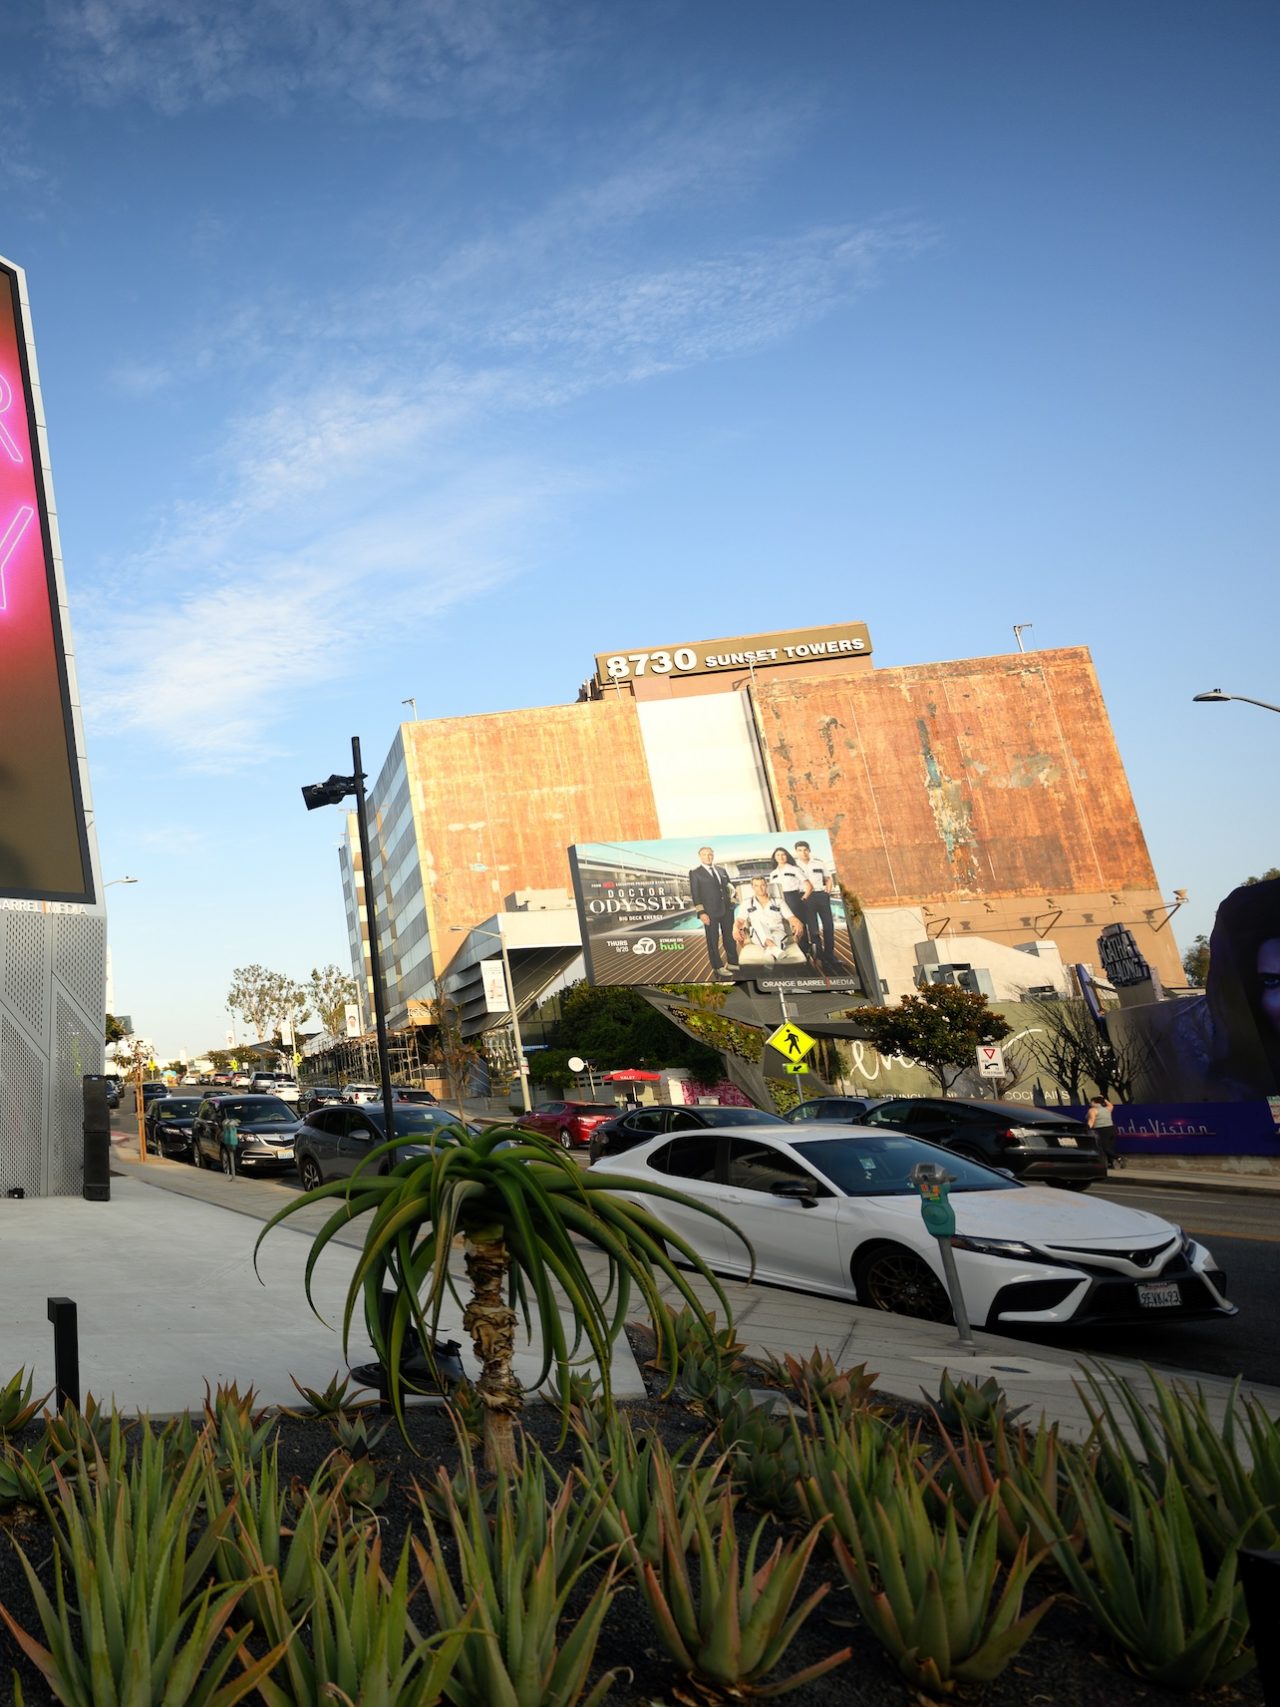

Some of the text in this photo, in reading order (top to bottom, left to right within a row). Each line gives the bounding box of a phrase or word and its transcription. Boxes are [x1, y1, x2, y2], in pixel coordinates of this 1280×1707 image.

[606, 637, 865, 679] 8730 SUNSET TOWERS
[608, 887, 665, 898] DOCTOR
[46, 901, 88, 915] MEDIA
[590, 896, 688, 914] ODYSSEY
[660, 942, 685, 951] hulu
[1005, 1091, 1070, 1101] COCAIS
[1117, 1118, 1209, 1138] ndaVision
